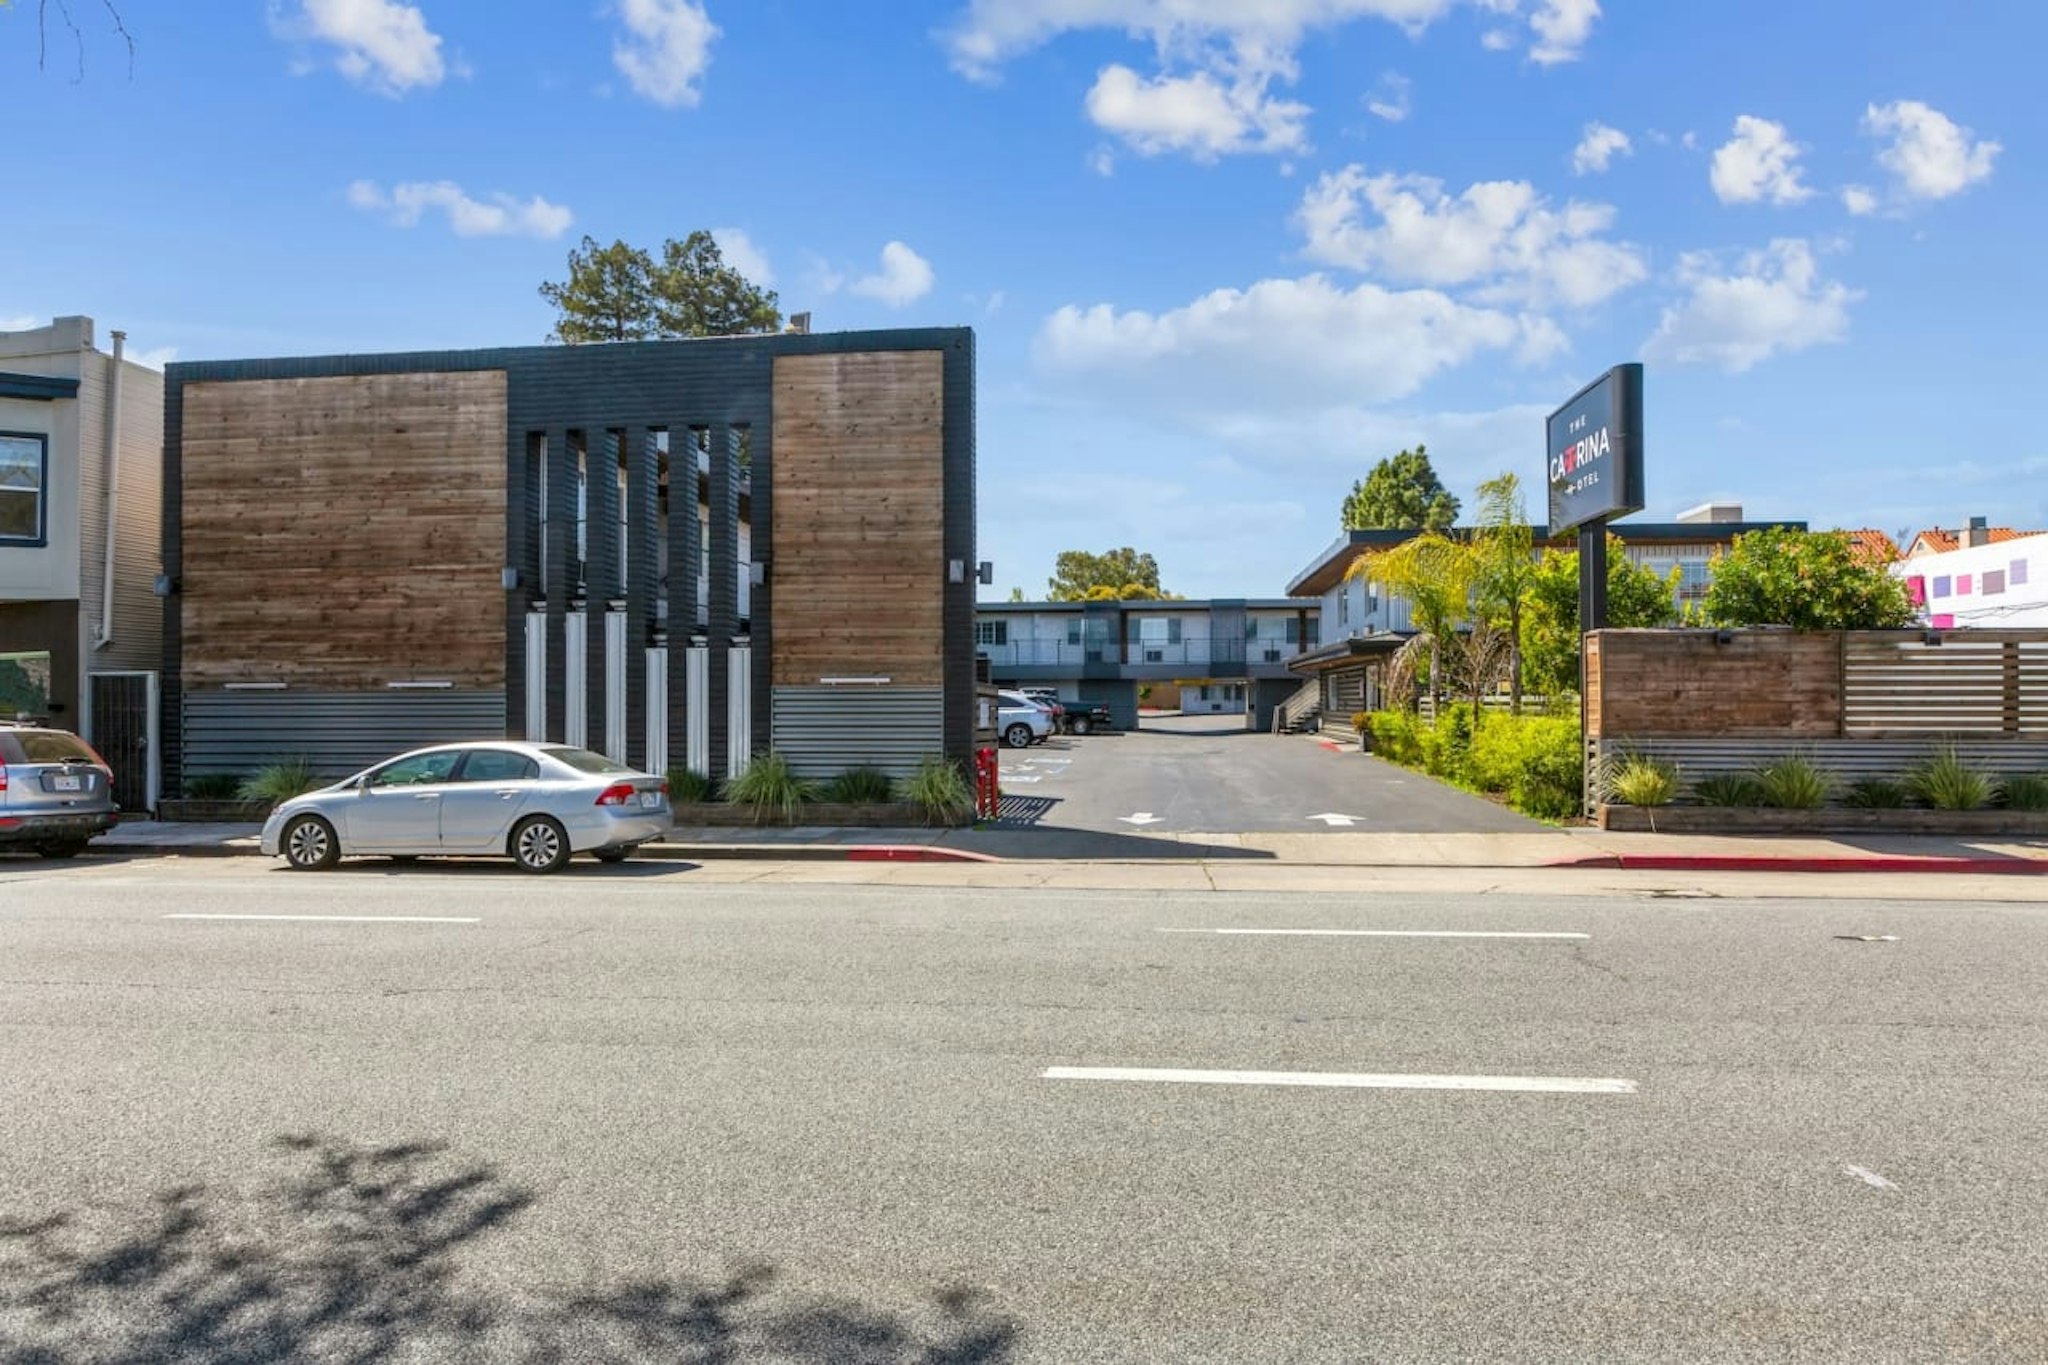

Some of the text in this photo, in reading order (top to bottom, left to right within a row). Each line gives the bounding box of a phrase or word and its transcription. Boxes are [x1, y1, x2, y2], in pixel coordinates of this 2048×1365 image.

[1569, 414, 1587, 434] THE
[1550, 427, 1610, 483] CATRINA
[1566, 471, 1599, 494] OTEL
